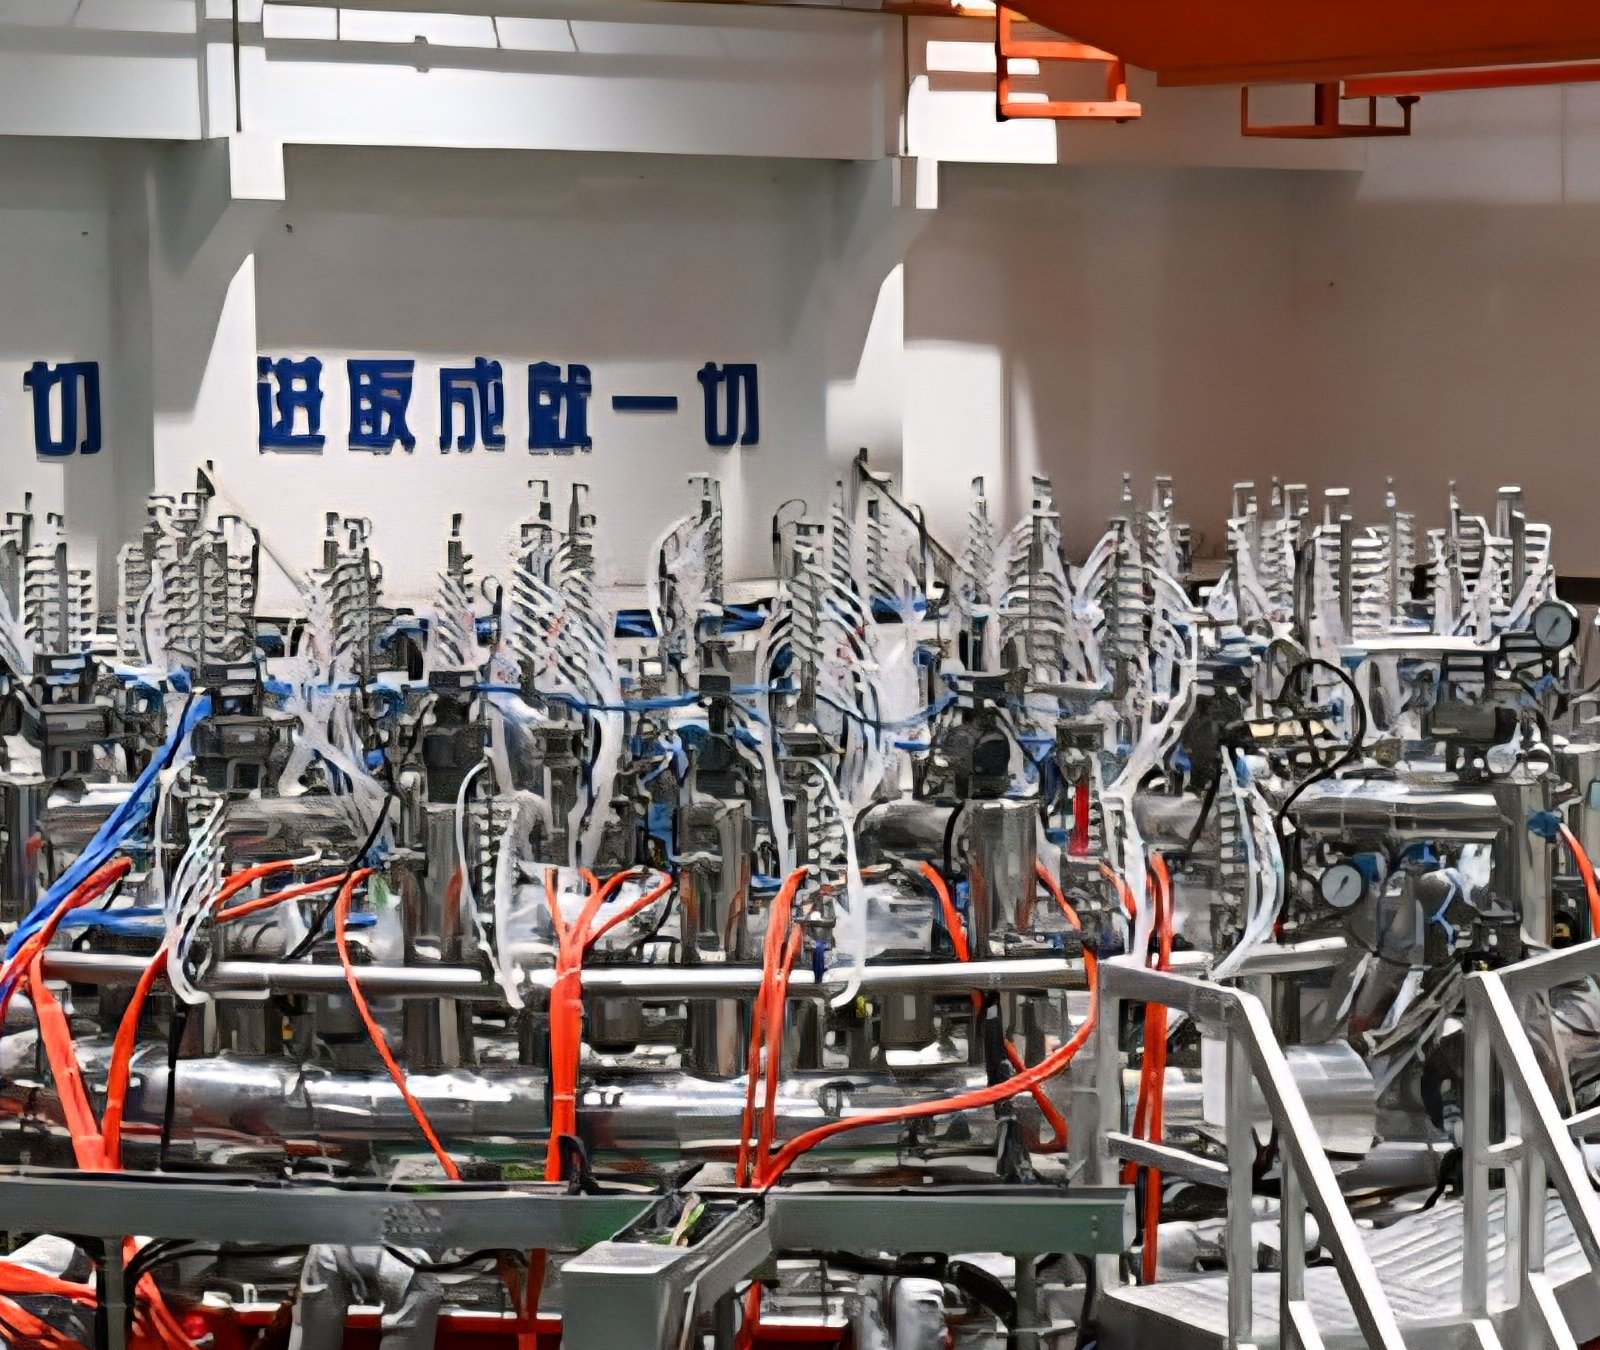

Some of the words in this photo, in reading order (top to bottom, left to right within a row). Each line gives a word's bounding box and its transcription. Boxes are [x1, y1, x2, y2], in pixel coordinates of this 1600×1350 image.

[257, 356, 759, 454] 进取成就一切
